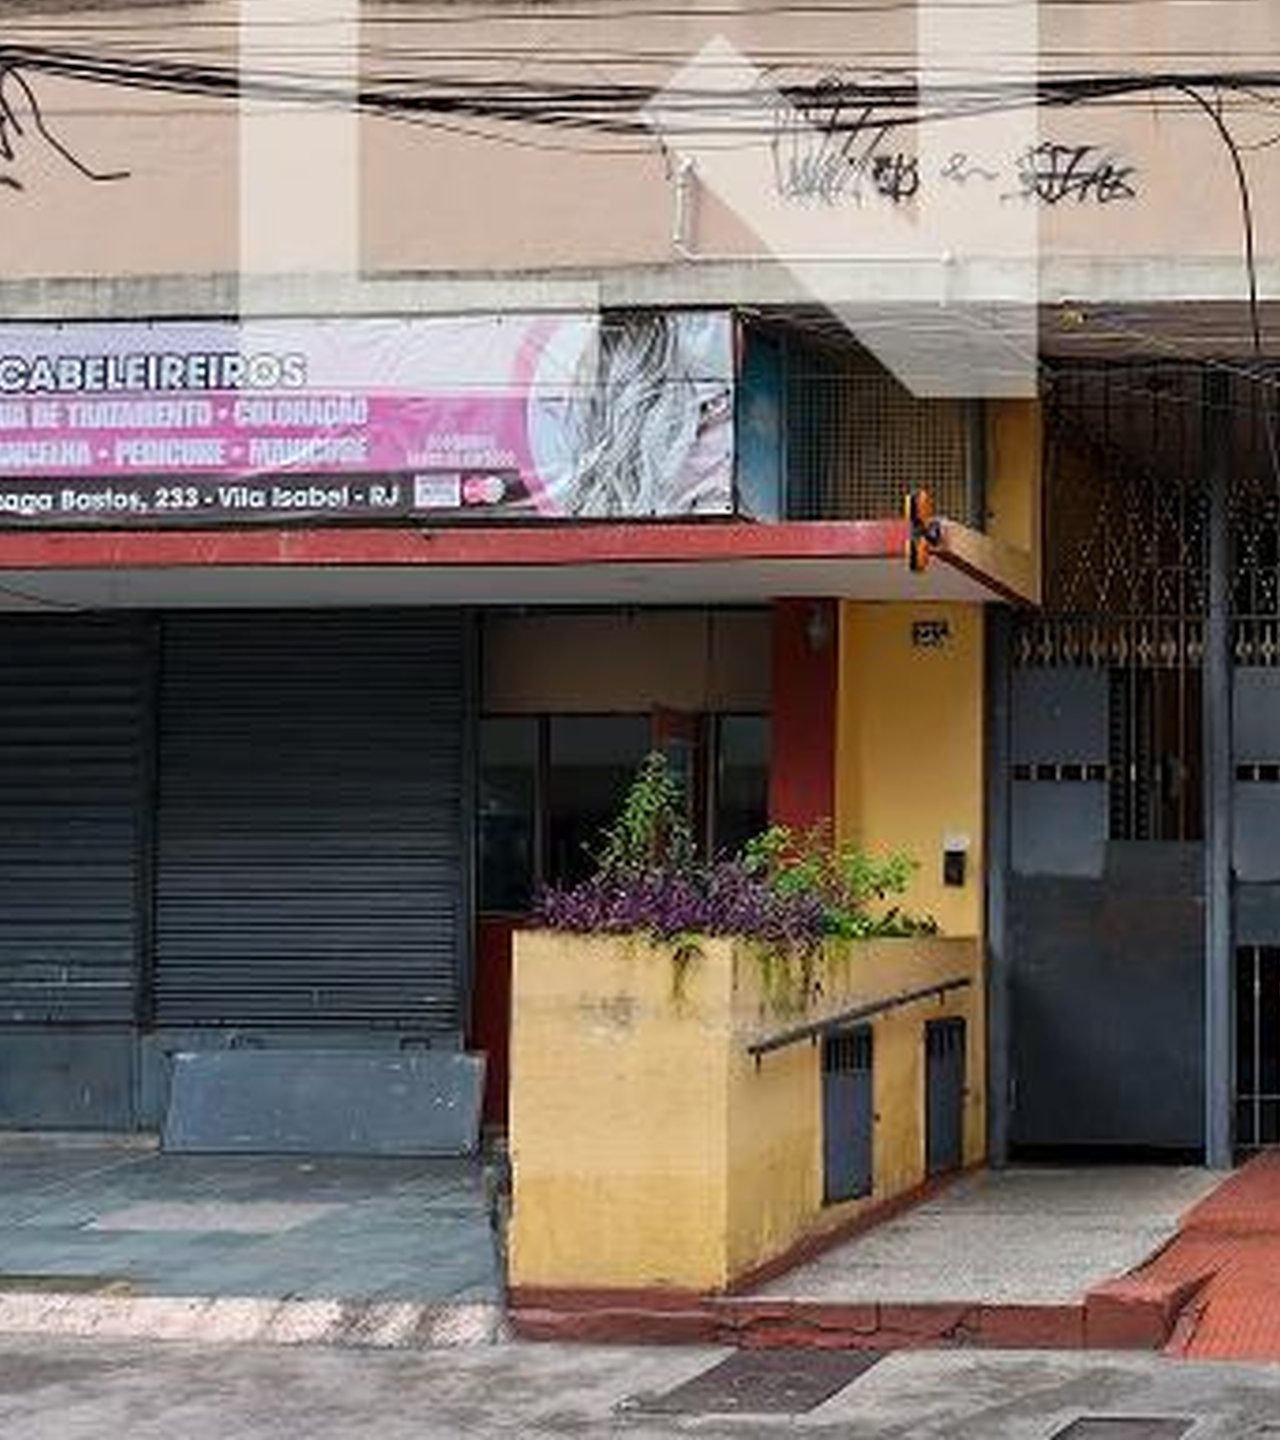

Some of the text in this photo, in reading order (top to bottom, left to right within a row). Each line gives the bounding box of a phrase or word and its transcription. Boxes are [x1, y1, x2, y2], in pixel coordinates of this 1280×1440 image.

[218, 485, 266, 509] Vila
[271, 484, 348, 509] Isabel
[369, 483, 399, 508] RJ
